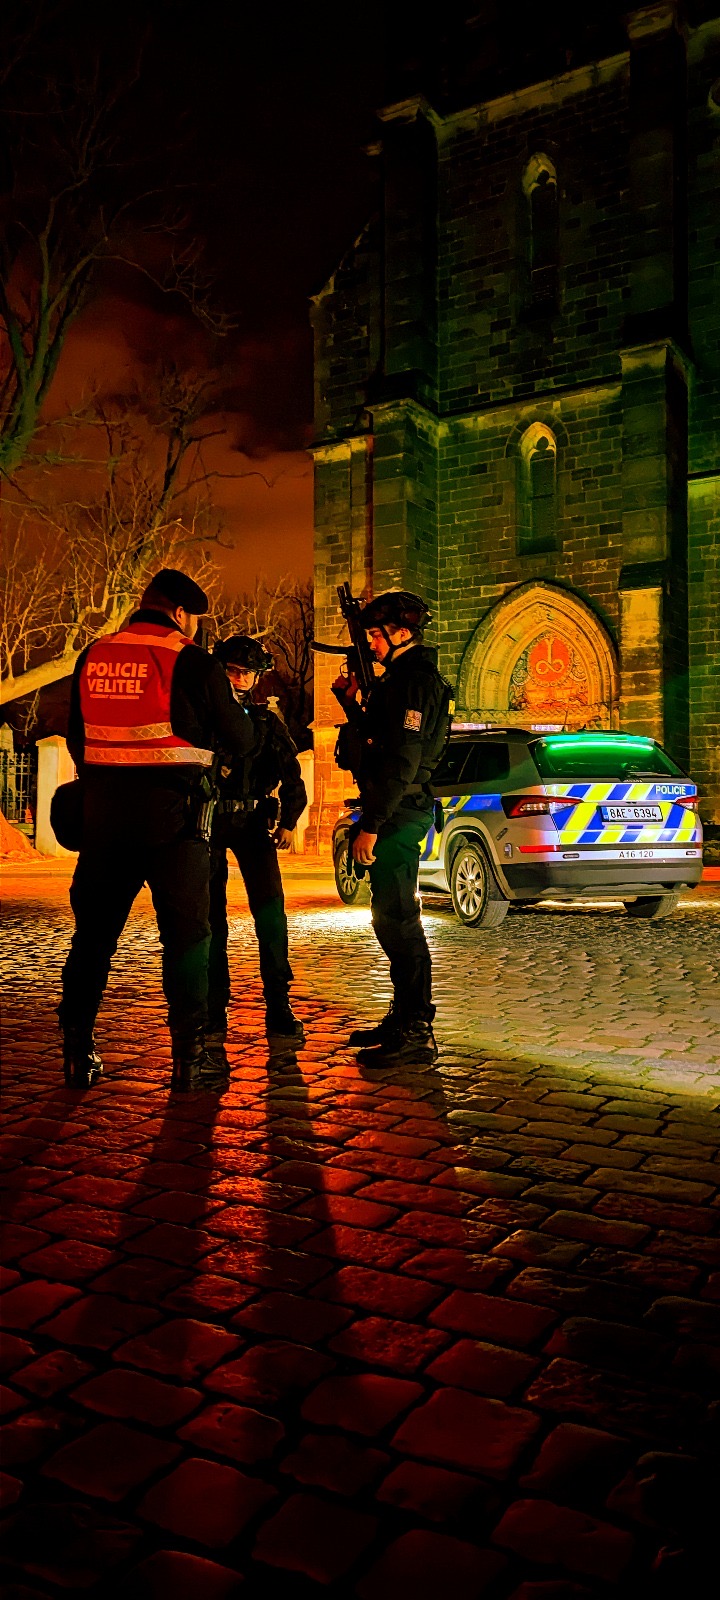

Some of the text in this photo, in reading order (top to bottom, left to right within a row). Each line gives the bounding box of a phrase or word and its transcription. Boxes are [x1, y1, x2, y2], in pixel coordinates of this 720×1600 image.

[86, 662, 148, 678] POLICIE
[87, 678, 144, 693] VELITEL
[655, 785, 686, 795] POLICIE
[609, 808, 627, 819] 8AE
[618, 850, 654, 859] A16 120
